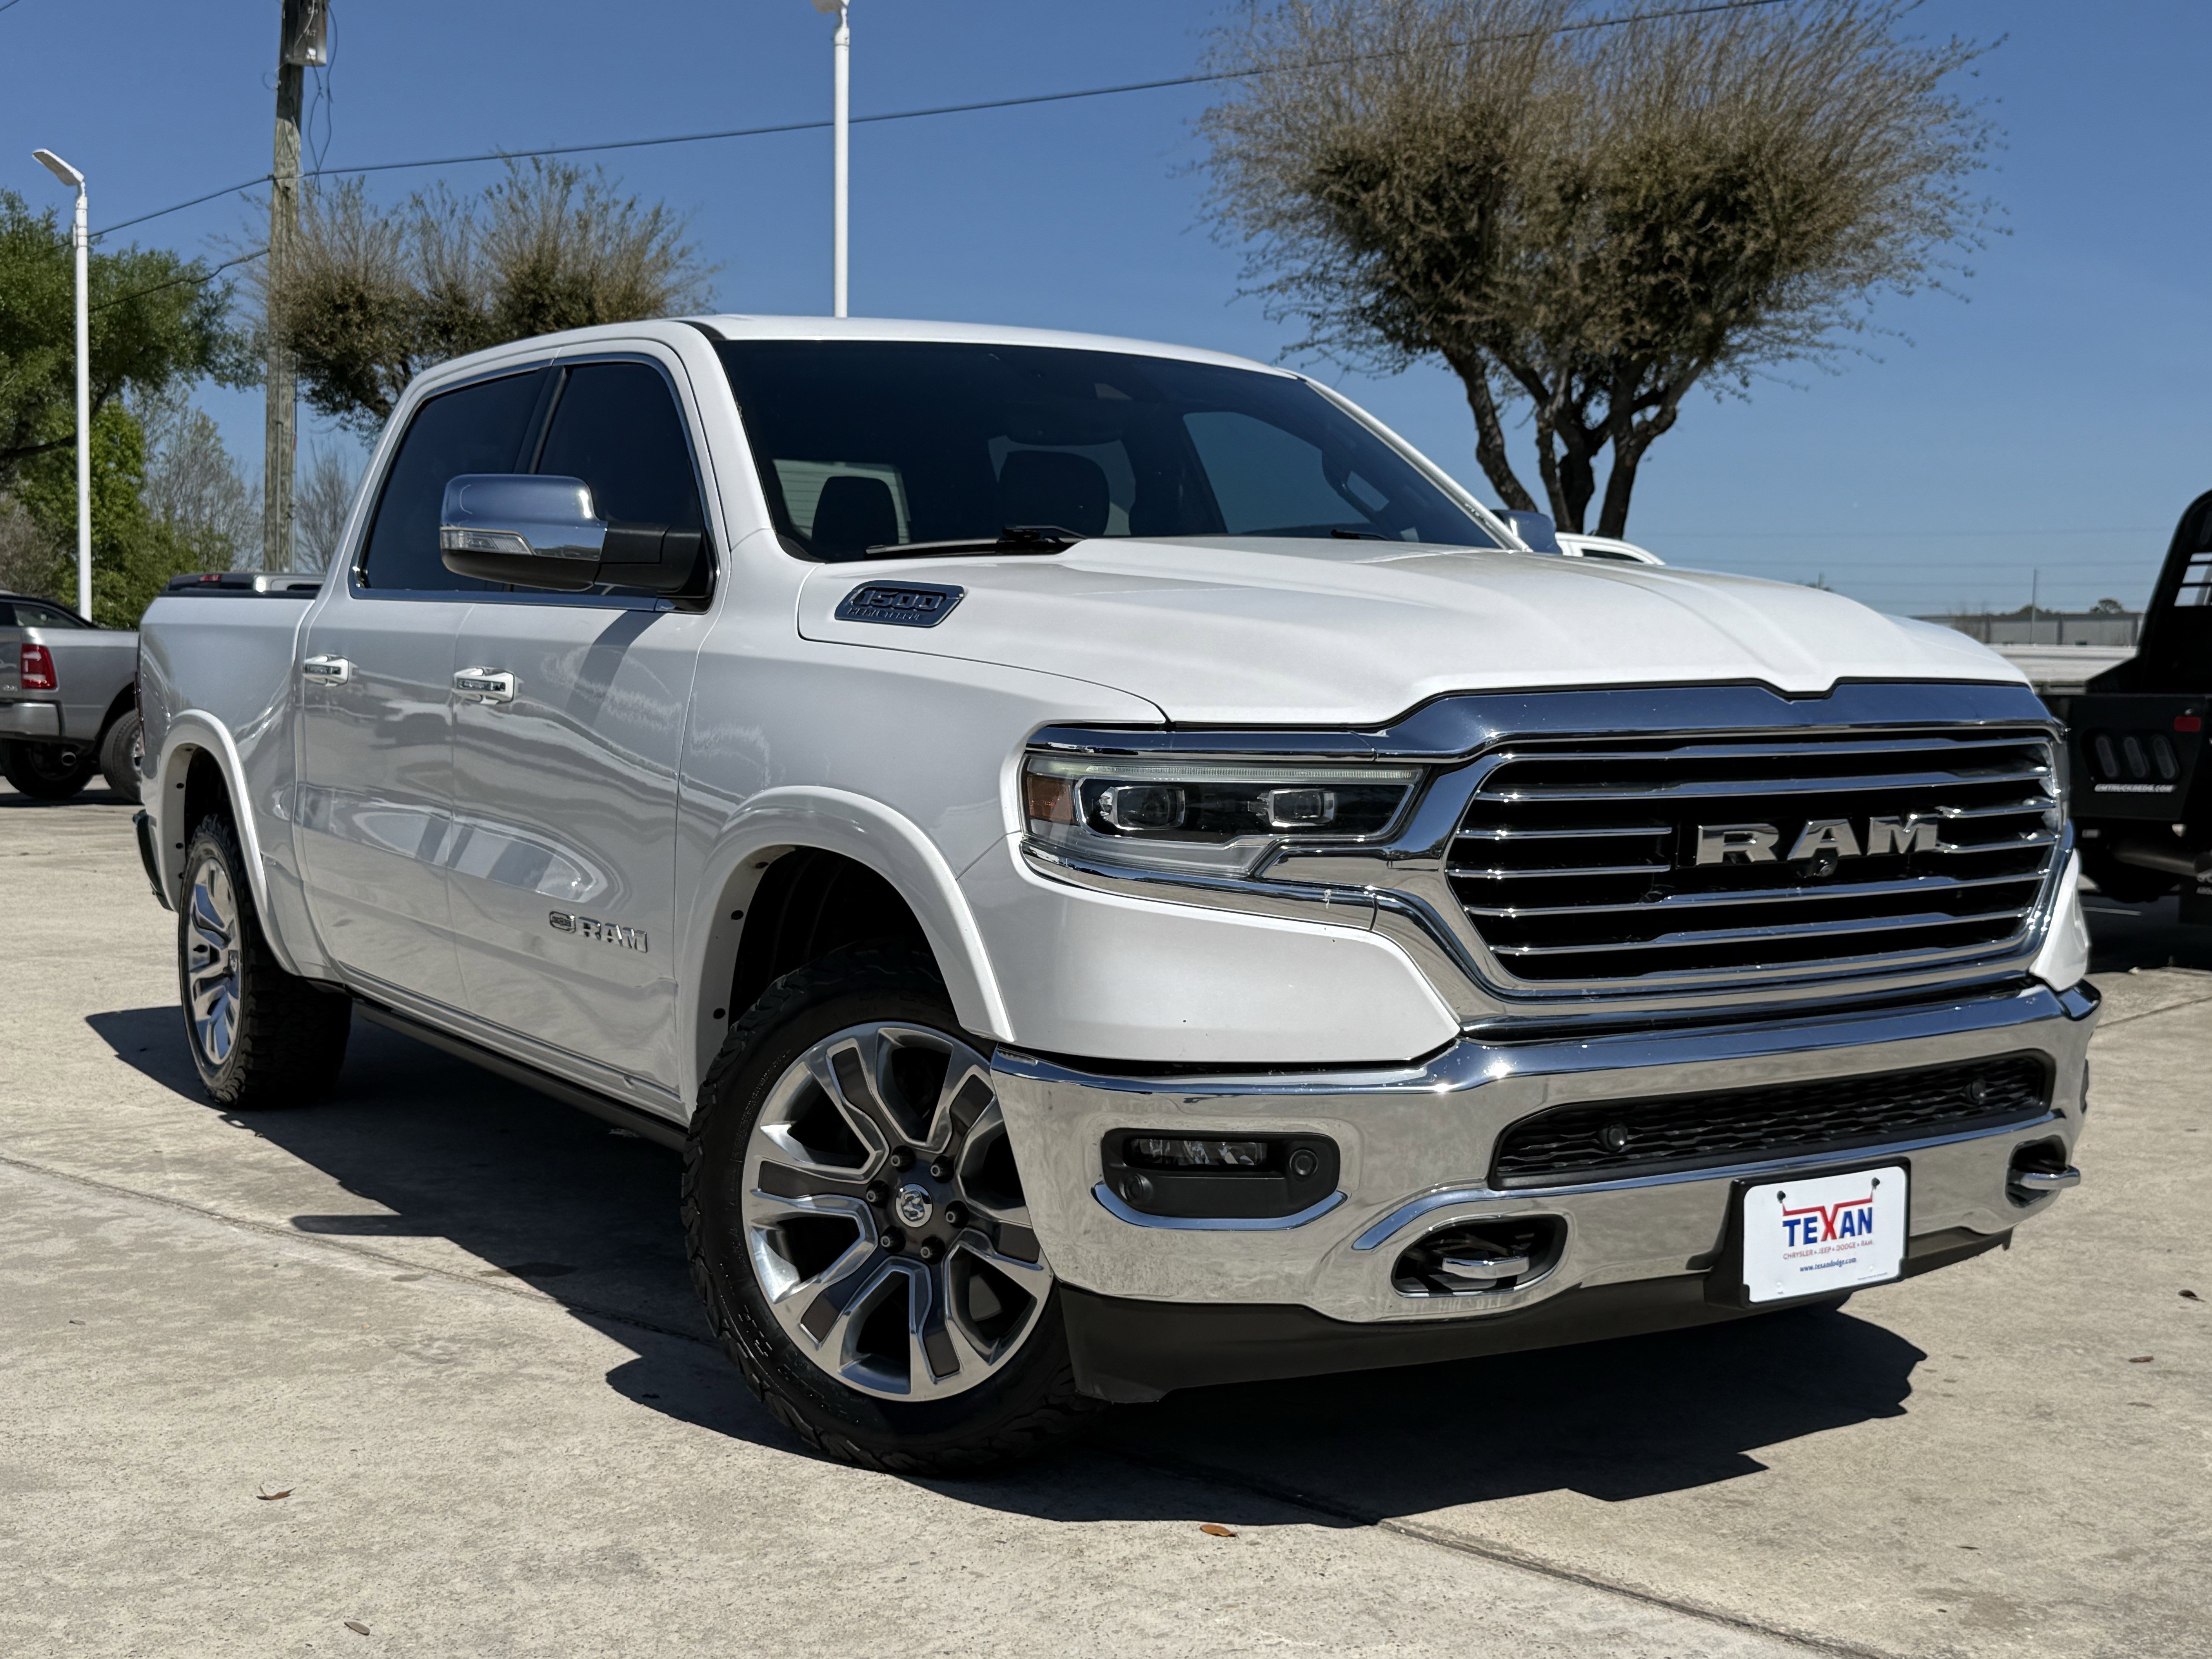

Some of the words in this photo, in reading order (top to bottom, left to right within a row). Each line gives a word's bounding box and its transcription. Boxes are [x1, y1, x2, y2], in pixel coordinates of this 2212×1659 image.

[860, 590, 944, 611] 1500
[1696, 815, 1939, 866] RAM
[579, 916, 648, 953] RAM
[1782, 1204, 1873, 1247] TEXAN
[1783, 1249, 1813, 1260] CHRYSLER
[1836, 1242, 1856, 1251] DODGE
[1800, 1257, 1856, 1272] www.texandodge.com
